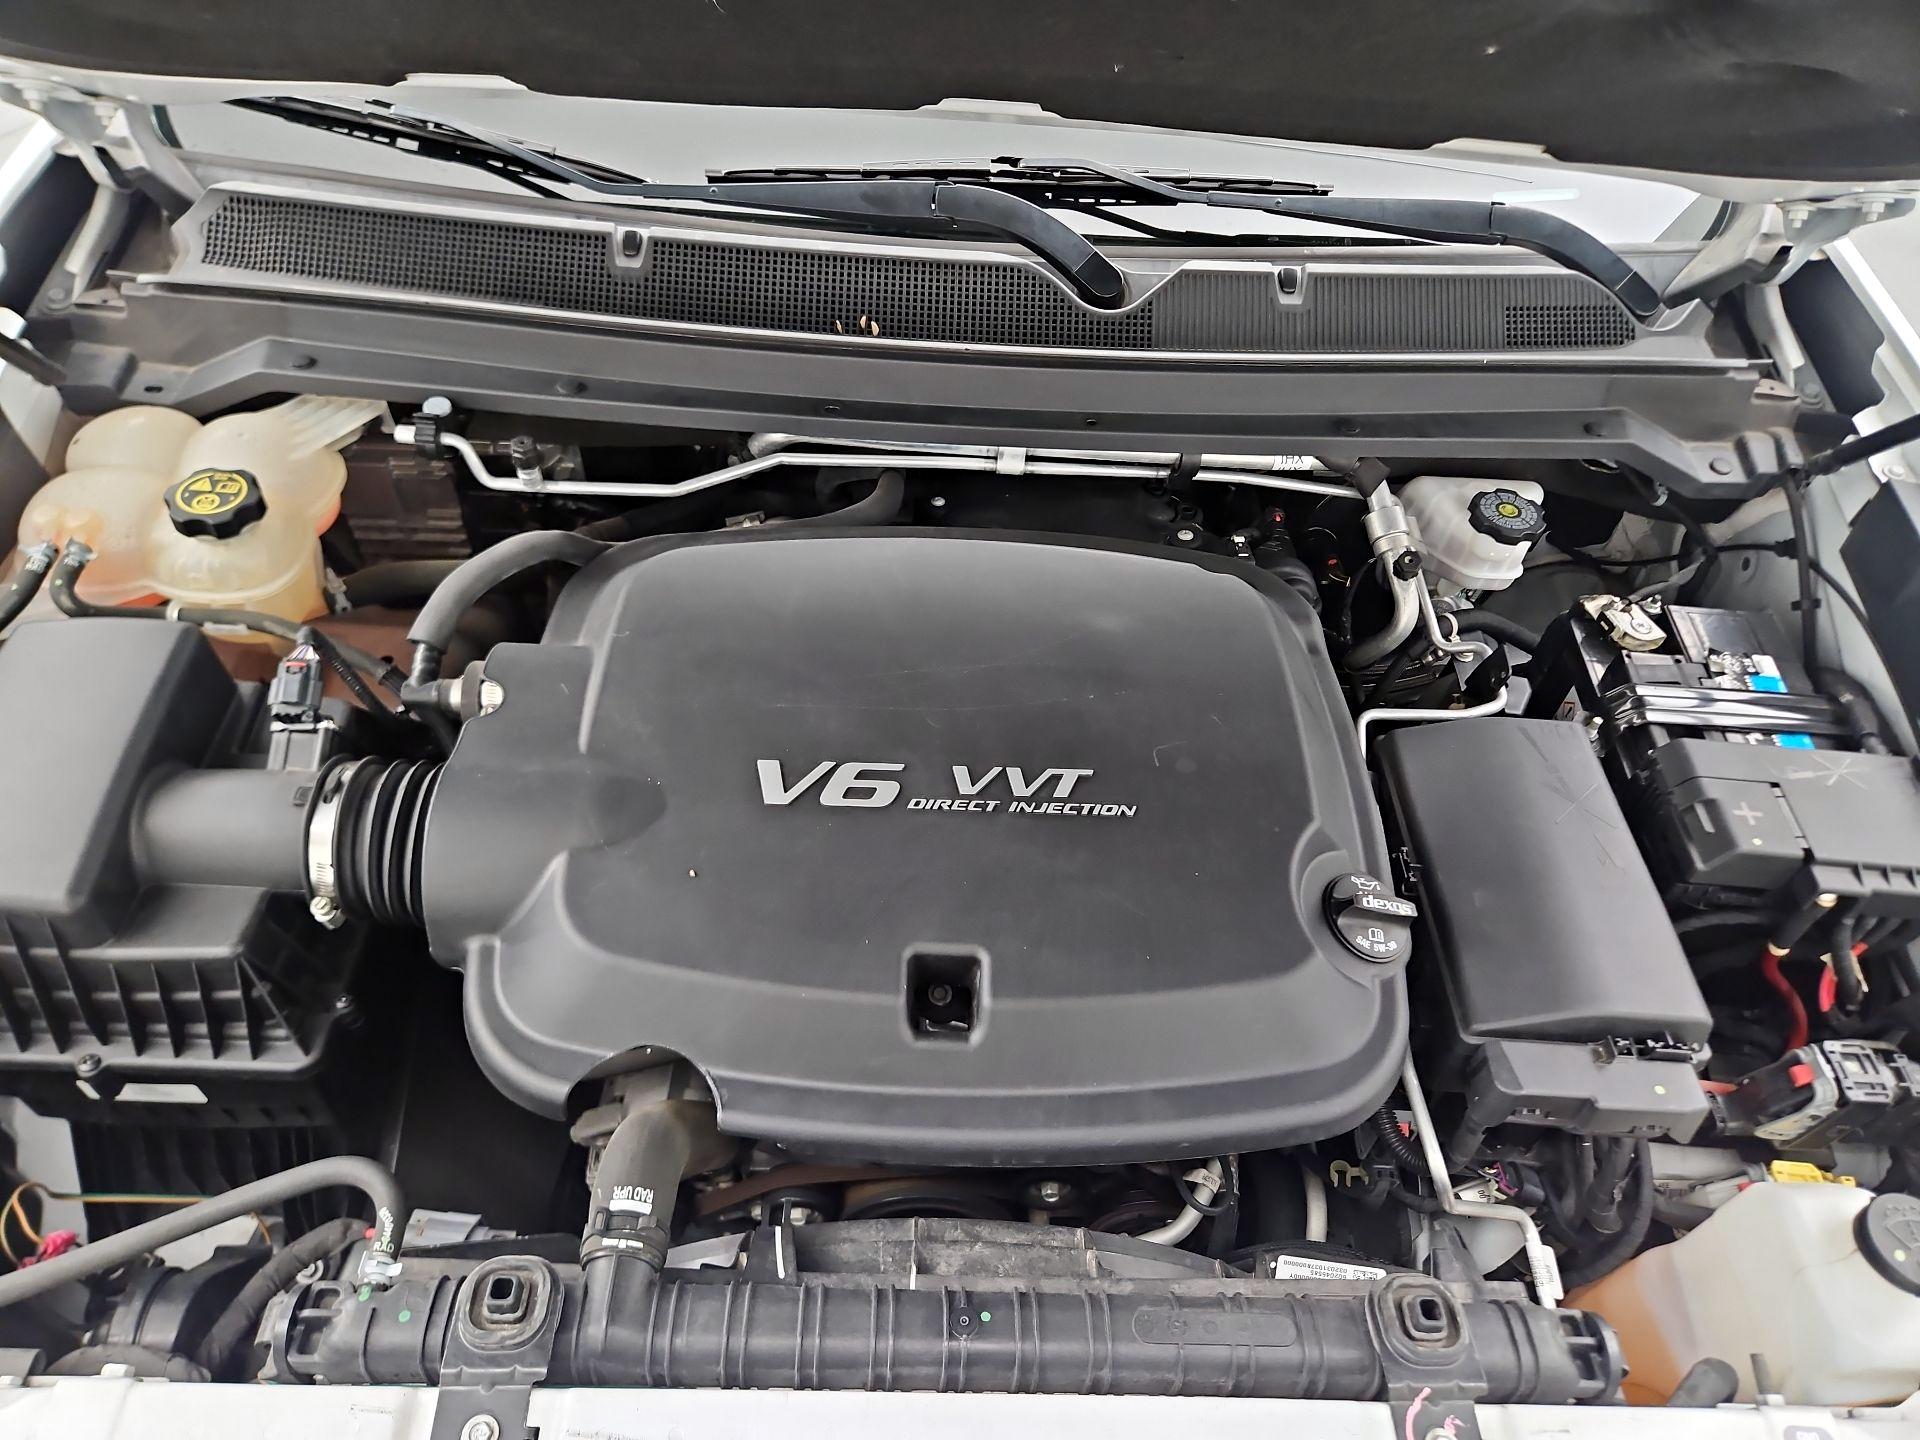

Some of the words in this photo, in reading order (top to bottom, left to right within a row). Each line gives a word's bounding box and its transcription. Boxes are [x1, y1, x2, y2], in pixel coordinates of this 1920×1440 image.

[757, 759, 905, 808] V6
[952, 765, 1094, 798] VVT
[906, 798, 1000, 813] DIRECT
[1008, 801, 1138, 817] INJECTION
[1362, 894, 1412, 916] dexos
[1356, 936, 1371, 949] SAE
[1373, 941, 1398, 952] 5W-30
[613, 1185, 632, 1199] UPR
[633, 1187, 653, 1203] RAD
[373, 1242, 394, 1252] RAD
